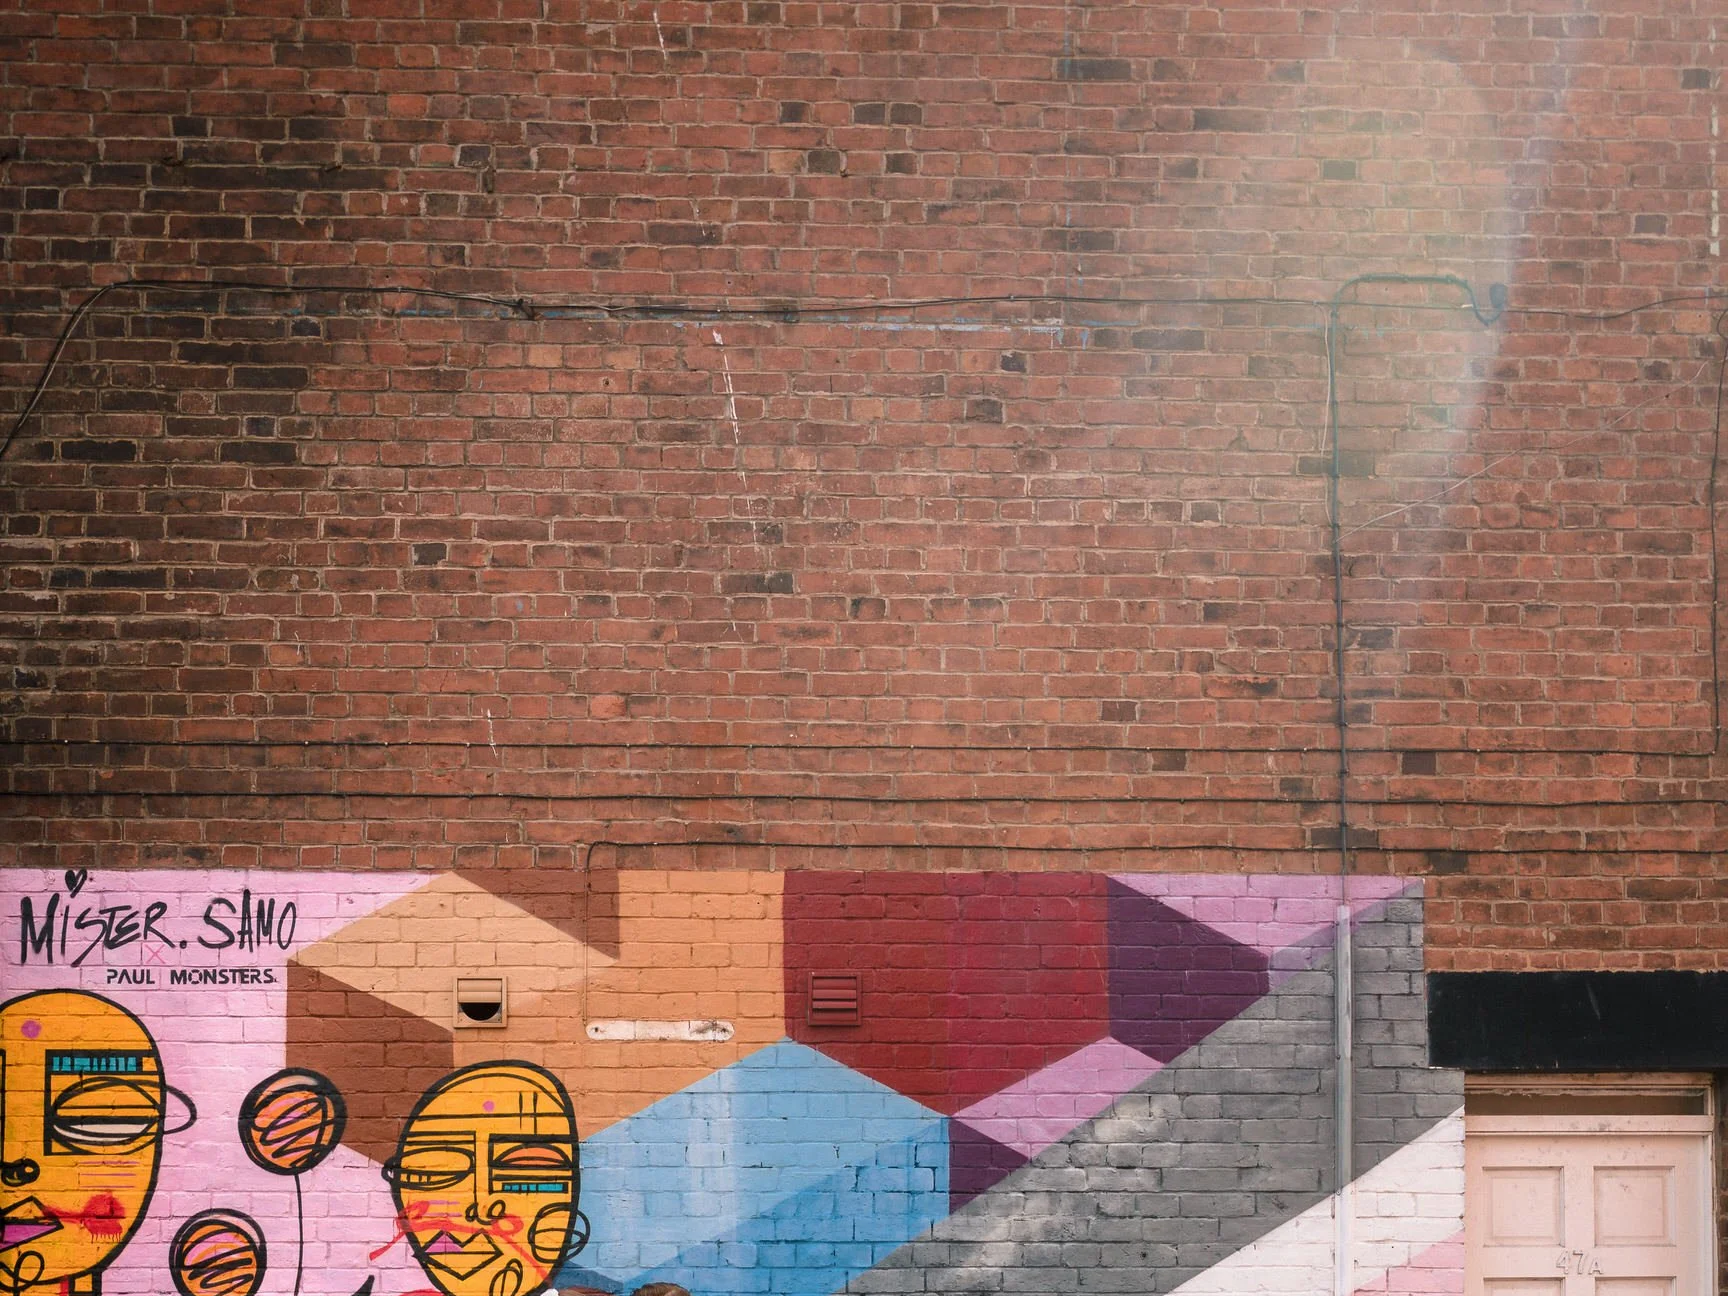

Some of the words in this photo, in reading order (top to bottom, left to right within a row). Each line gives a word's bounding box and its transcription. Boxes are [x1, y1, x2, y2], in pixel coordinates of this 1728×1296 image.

[198, 889, 297, 951] SAMO
[106, 969, 155, 985] PAUL
[1556, 1249, 1603, 1275] 47A
